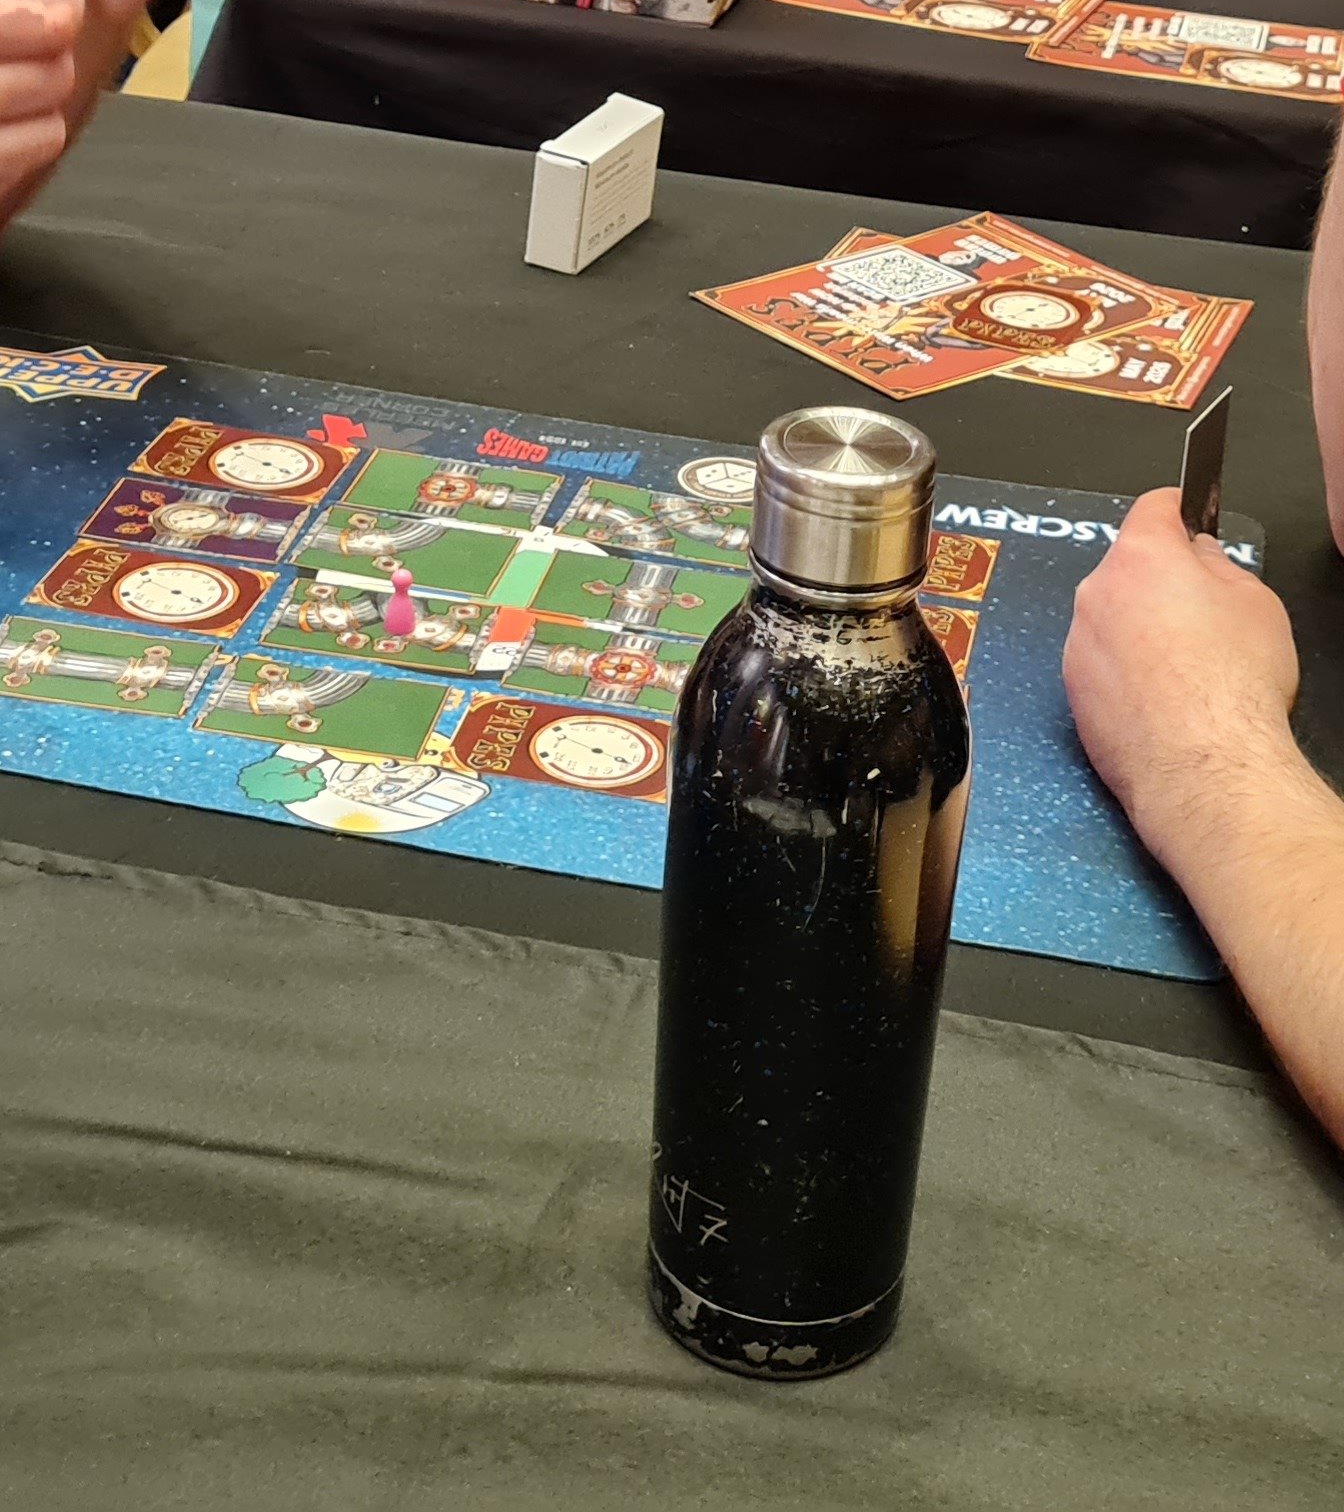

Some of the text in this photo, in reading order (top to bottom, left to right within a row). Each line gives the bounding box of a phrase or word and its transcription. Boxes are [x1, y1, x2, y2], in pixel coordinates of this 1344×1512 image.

[476, 427, 551, 463] GAMES
[52, 548, 132, 607] PIPES
[466, 701, 537, 772] PIPES
